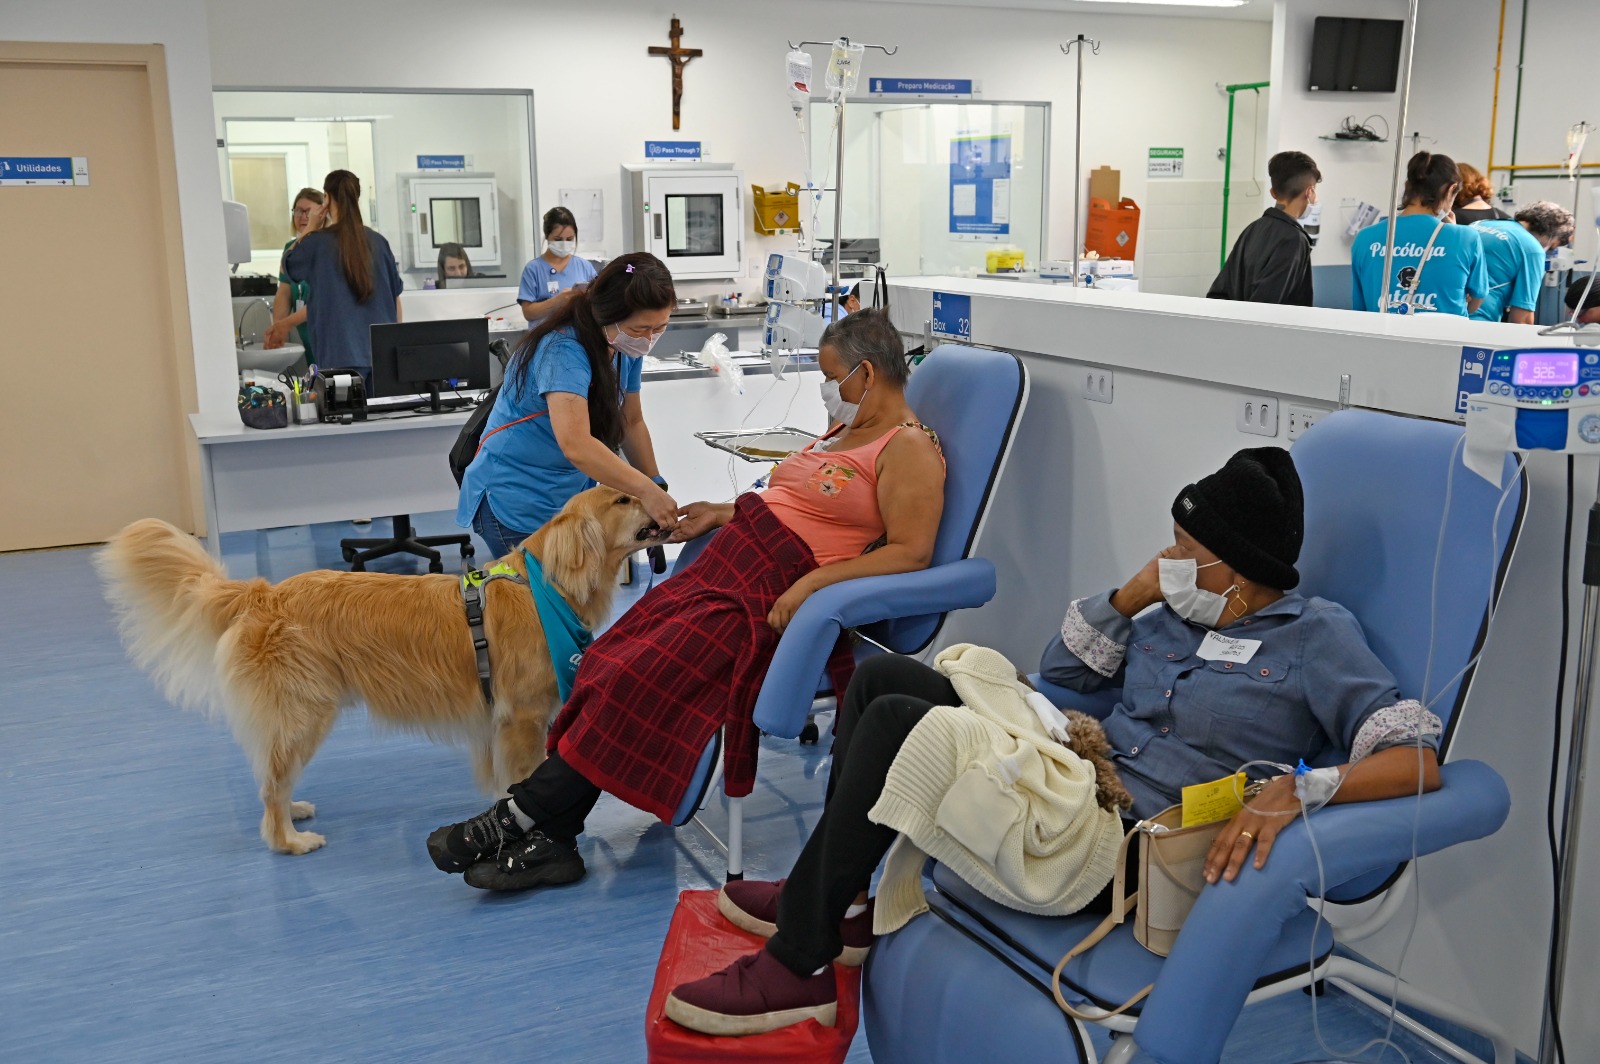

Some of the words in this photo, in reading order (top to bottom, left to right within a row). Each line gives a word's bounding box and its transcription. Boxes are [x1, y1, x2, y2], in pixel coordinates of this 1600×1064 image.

[897, 82, 922, 91] Preparo
[923, 82, 955, 91] Medicação
[674, 147, 696, 155] Through
[16, 164, 62, 172] Utilidades
[1369, 242, 1446, 261] Pscóloa
[1377, 289, 1437, 309] tac
[933, 317, 946, 331] Box
[958, 317, 969, 335] 32
[1532, 366, 1556, 379] 926
[524, 845, 536, 854] FILA
